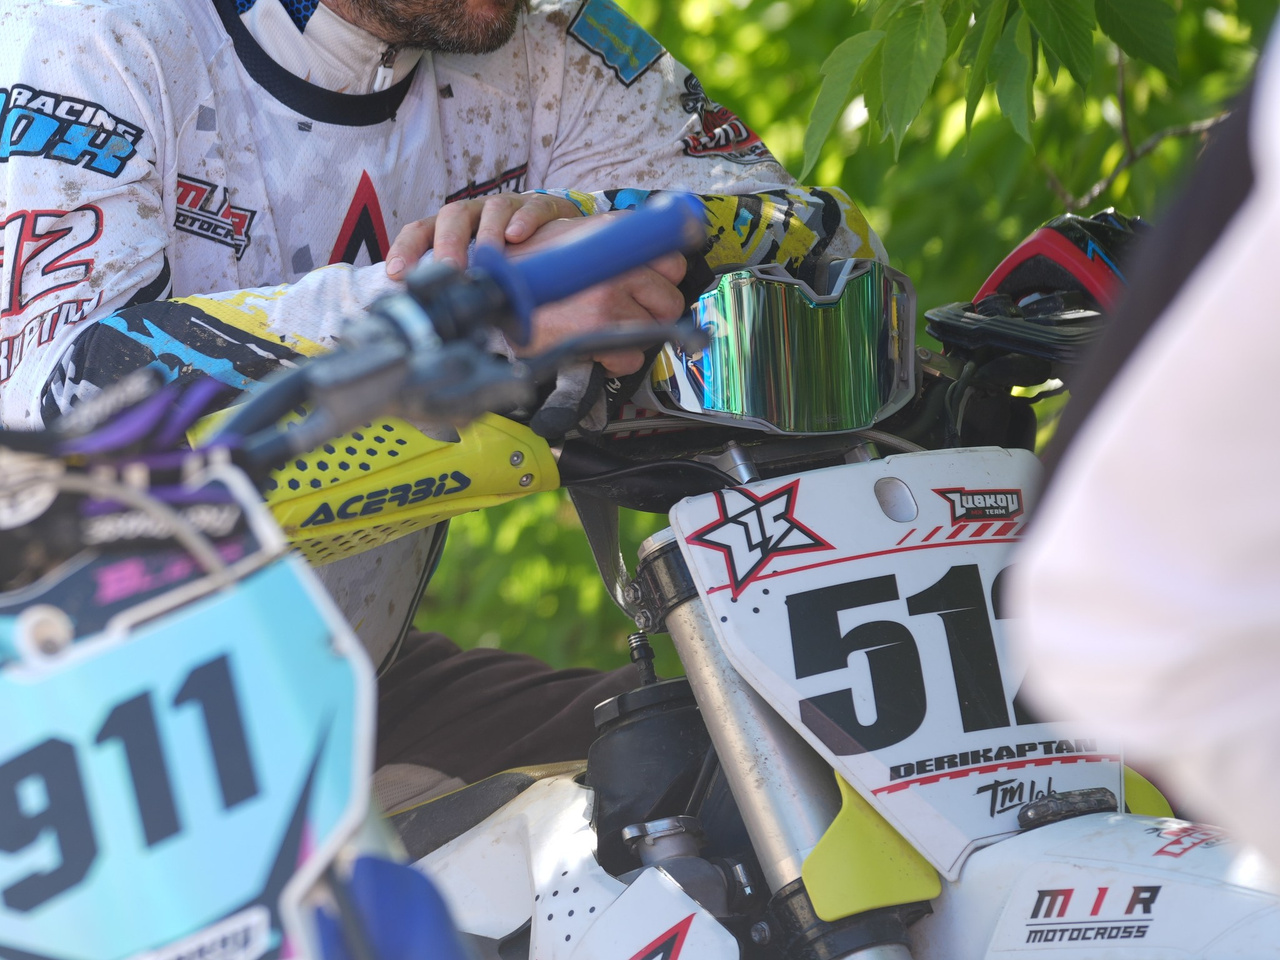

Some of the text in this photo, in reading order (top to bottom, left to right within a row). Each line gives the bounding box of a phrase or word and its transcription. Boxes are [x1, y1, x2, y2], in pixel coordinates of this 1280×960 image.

[9, 87, 138, 143] RACING
[300, 470, 472, 529] ACERBIS
[889, 738, 1098, 782] DERIKAPTAN
[1025, 924, 1150, 944] MOTOCROSS
